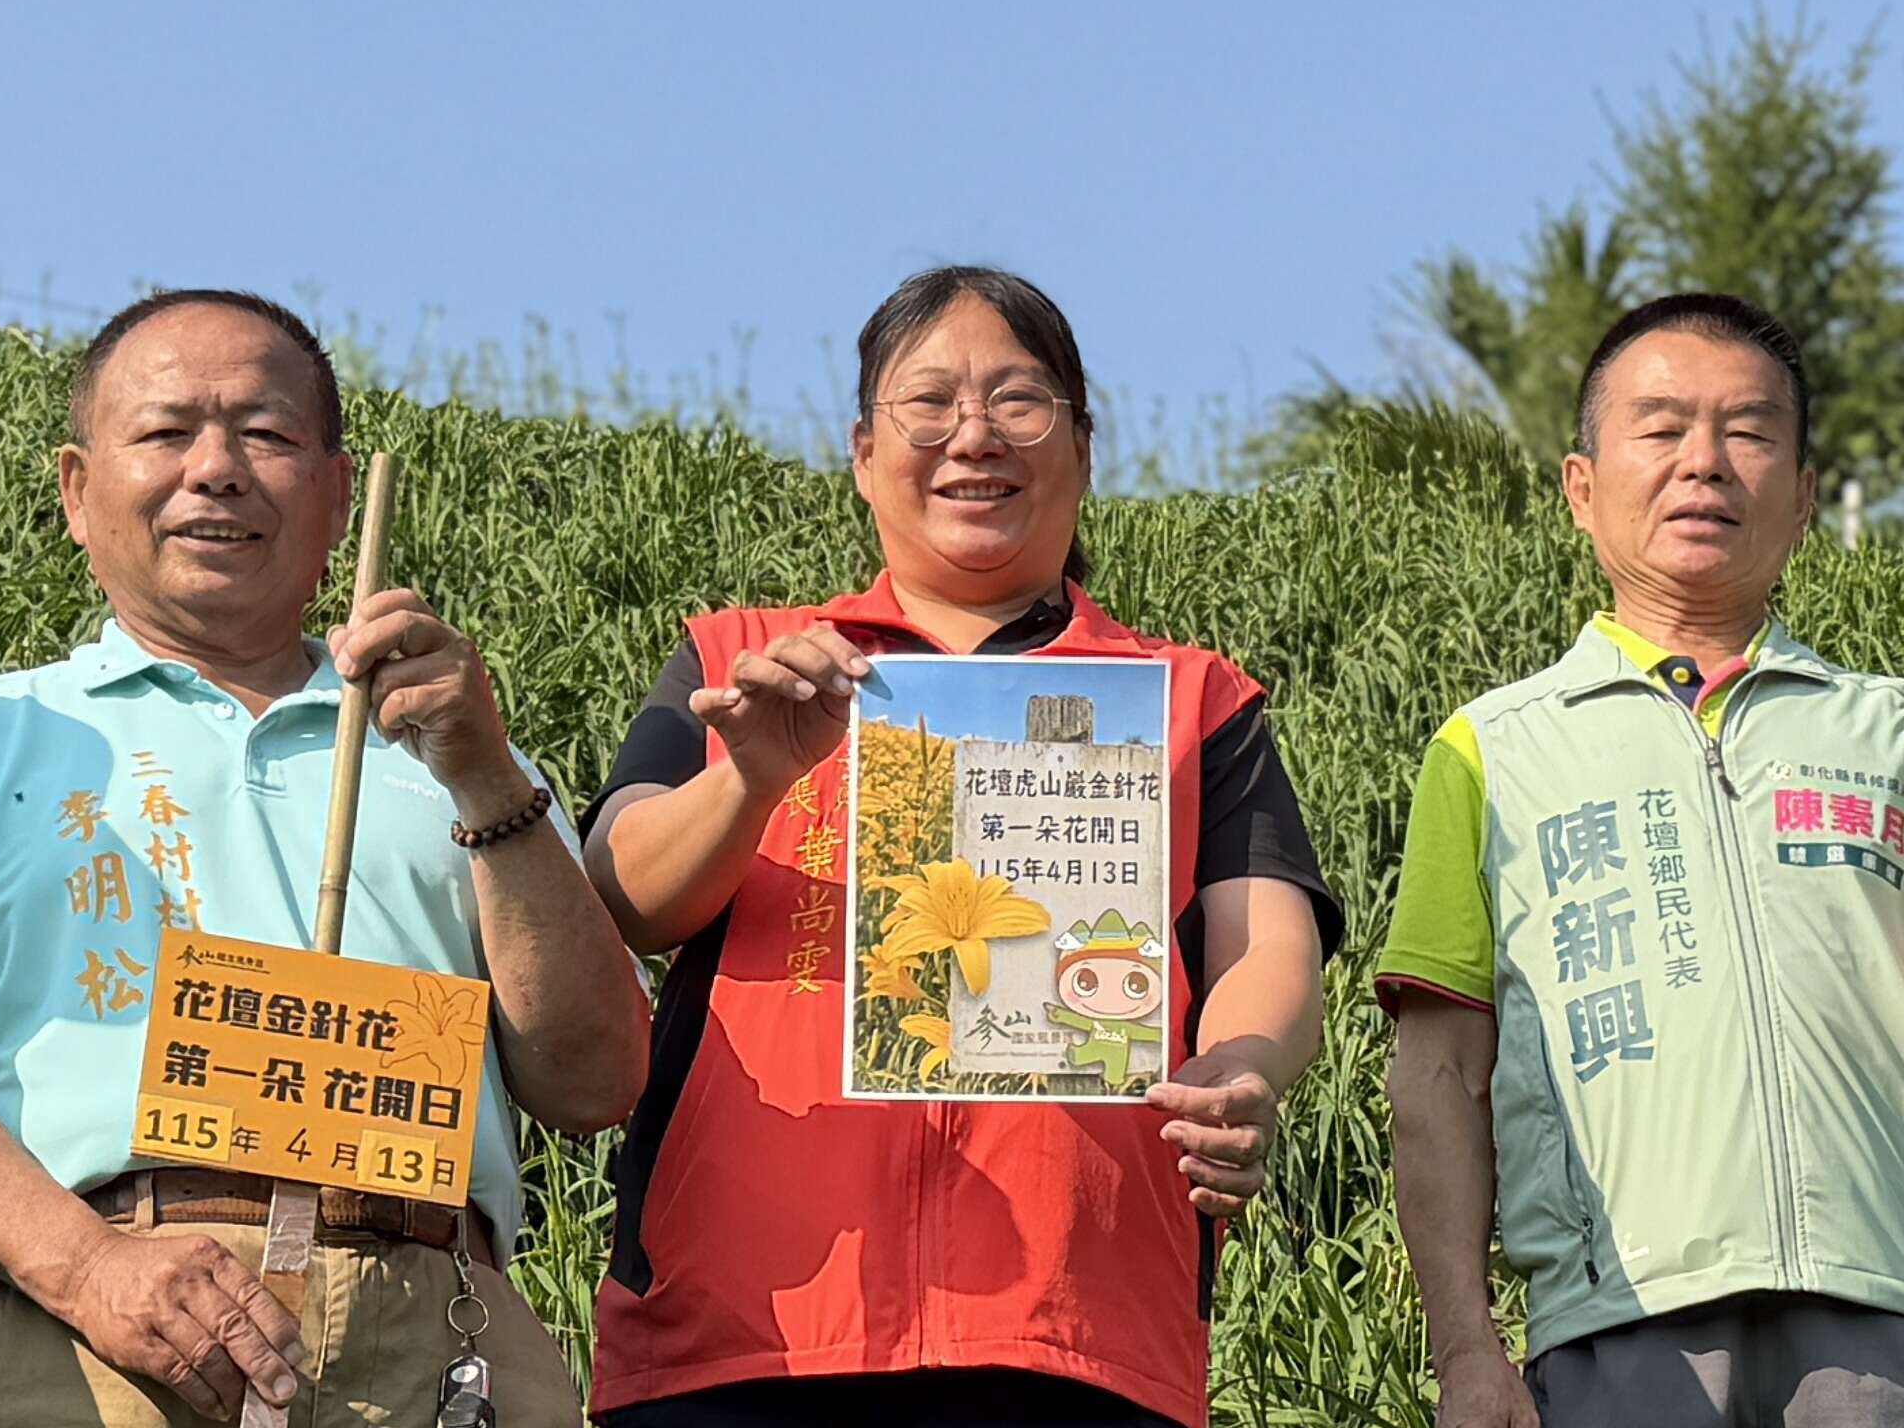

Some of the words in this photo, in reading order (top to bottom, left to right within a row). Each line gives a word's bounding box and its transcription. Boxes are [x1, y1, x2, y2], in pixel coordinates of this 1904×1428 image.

[965, 767, 1161, 802] 花壇虎山巖金針花
[980, 812, 1139, 844] 第一朵花開日
[979, 857, 1139, 885] 115年4月13日
[1637, 788, 1703, 990] 花壇鄉民代表
[1536, 799, 1656, 1086] 陳新興
[173, 977, 400, 1053] 花壇金針花
[162, 1040, 305, 1105] 第一朵
[322, 1067, 463, 1131] 花開日
[142, 1107, 220, 1150] 115
[231, 1124, 263, 1155] 年
[285, 1127, 313, 1164] 4
[330, 1141, 360, 1173] 月
[375, 1145, 425, 1185] 13
[433, 1156, 456, 1188] 日
